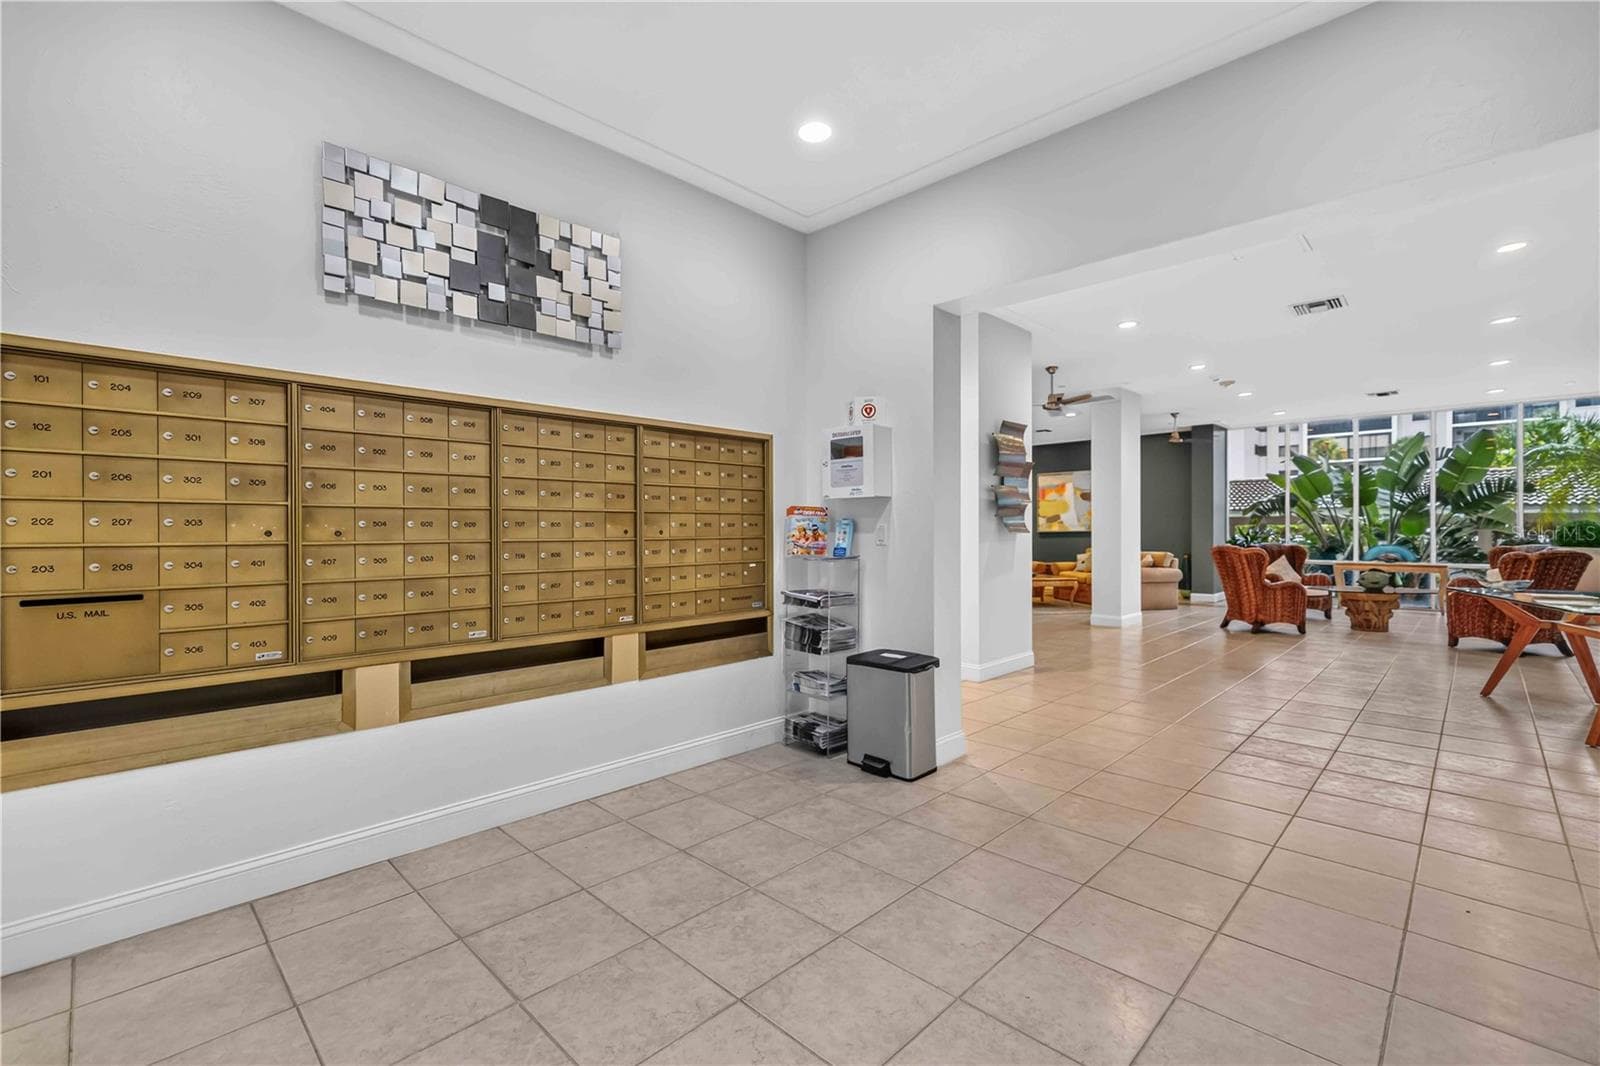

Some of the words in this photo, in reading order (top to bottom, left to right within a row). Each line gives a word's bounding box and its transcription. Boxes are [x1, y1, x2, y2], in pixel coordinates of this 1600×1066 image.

[33, 375, 49, 383] 101
[110, 383, 131, 392] 204
[183, 391, 202, 399] 209
[248, 398, 265, 406] 307
[32, 423, 51, 431] 102
[111, 428, 132, 437] 205
[185, 434, 201, 442] 301
[248, 438, 265, 446] 308
[32, 470, 52, 478] 201
[111, 473, 132, 481] 206
[183, 476, 202, 484] 302
[31, 518, 54, 526] 202
[112, 518, 132, 526] 207
[32, 565, 55, 573] 203
[112, 563, 133, 571] 208
[184, 561, 203, 569] 304
[184, 603, 204, 611] 305
[57, 610, 77, 620] U.S.
[84, 610, 110, 618] MAIL
[249, 640, 267, 648] 403
[184, 646, 203, 654] 306
